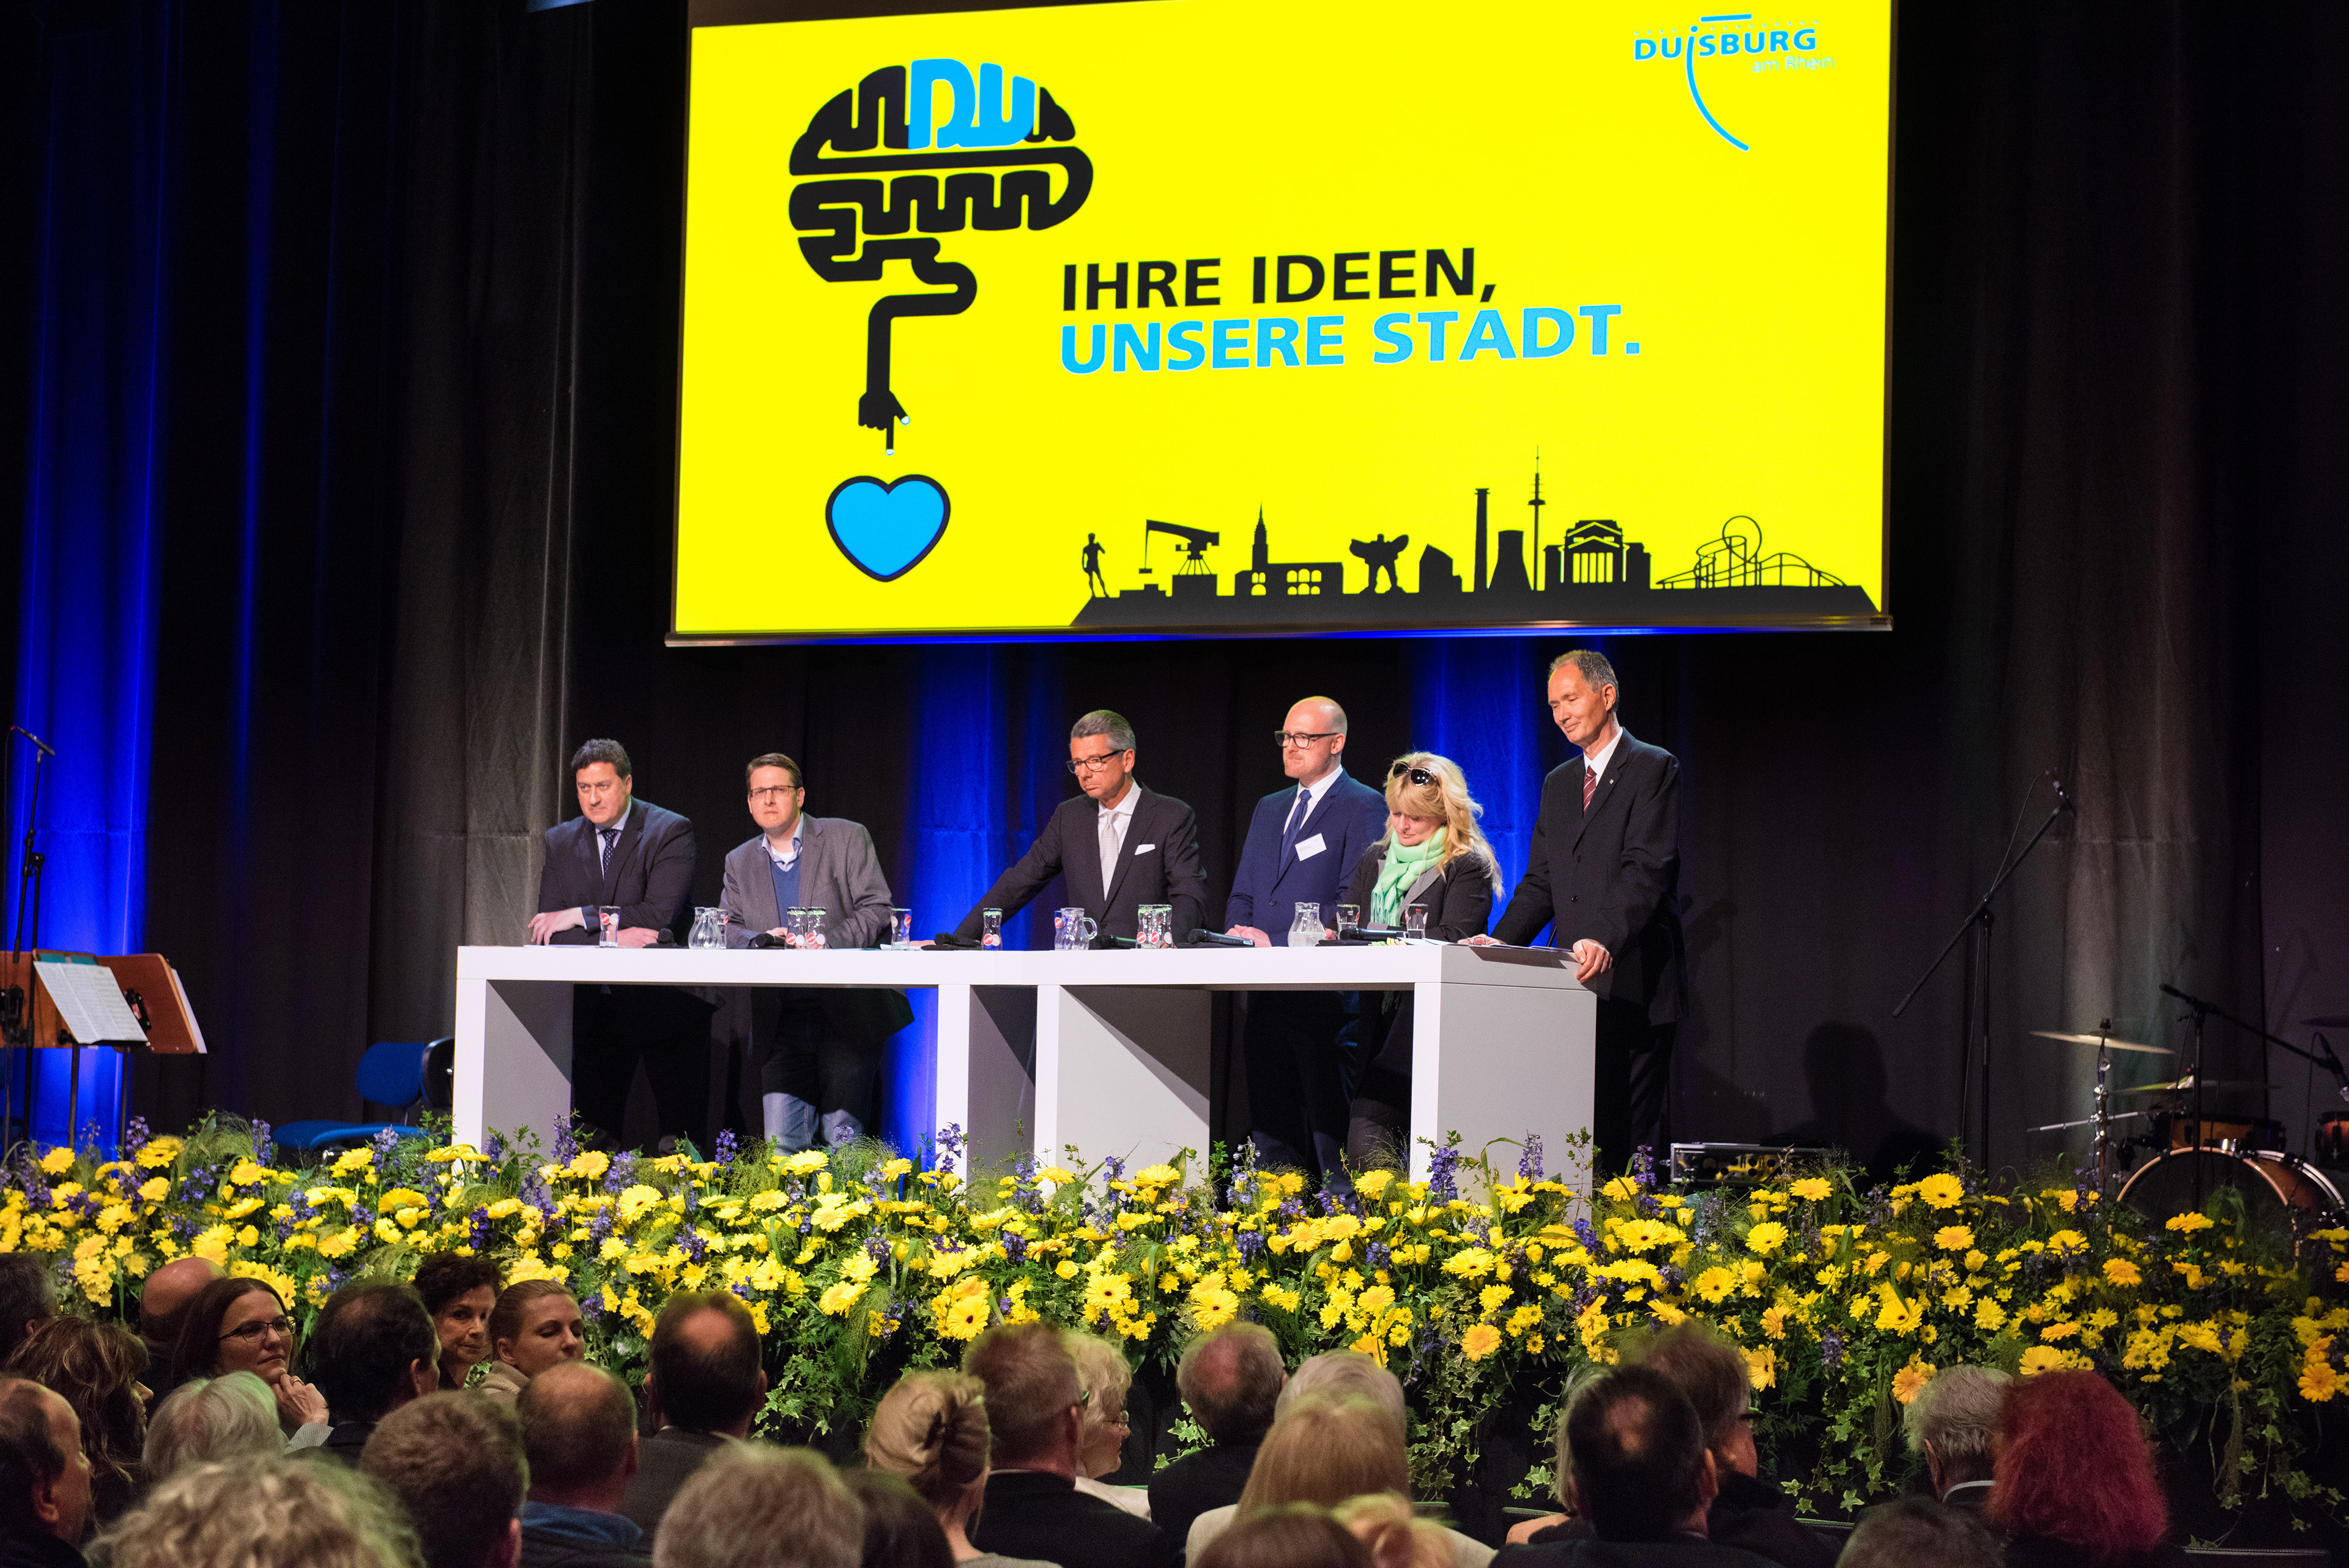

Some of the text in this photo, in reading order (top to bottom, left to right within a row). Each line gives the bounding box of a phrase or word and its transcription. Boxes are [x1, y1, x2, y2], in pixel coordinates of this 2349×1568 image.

[1751, 54, 1834, 73] am Rhein
[1063, 247, 1497, 311] IHRE IDEEN,
[1061, 305, 1640, 374] UNSERE STADT.
